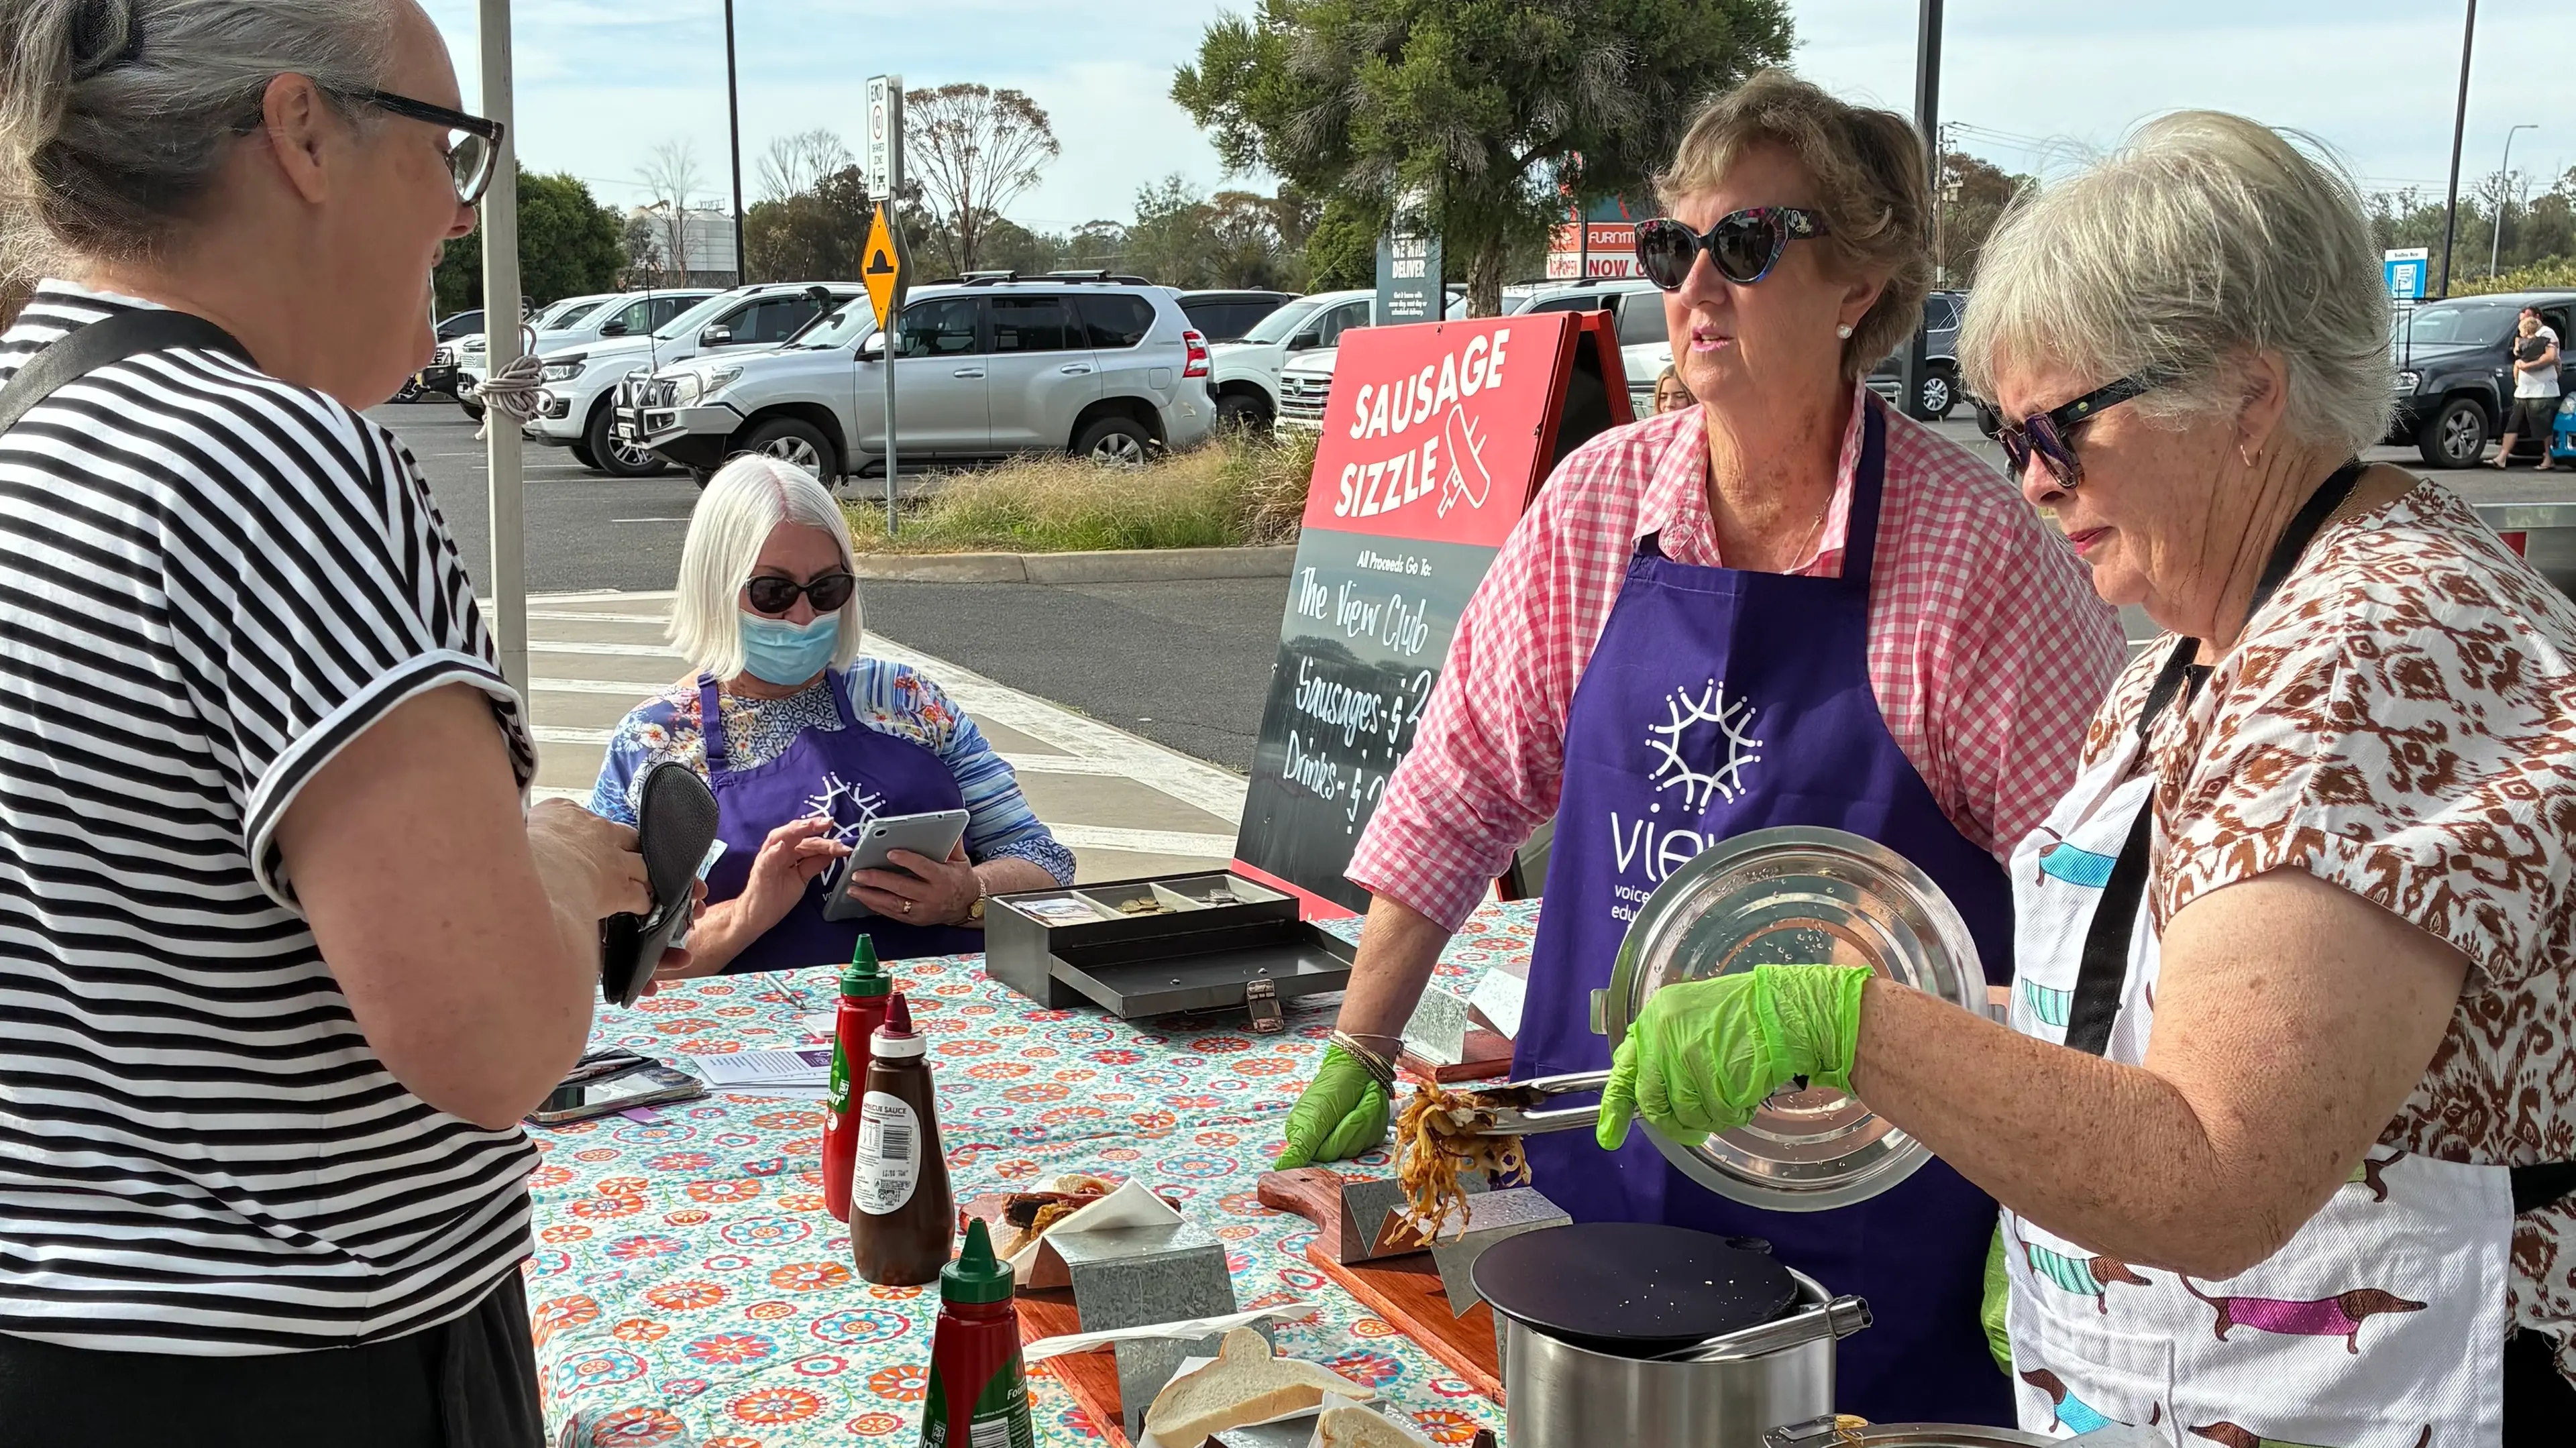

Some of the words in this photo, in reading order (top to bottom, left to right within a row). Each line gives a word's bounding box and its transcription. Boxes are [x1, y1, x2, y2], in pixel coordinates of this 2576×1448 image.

[871, 83, 883, 102] END
[1392, 260, 1426, 278] DELIVER
[1589, 260, 1629, 276] NOW
[1350, 328, 1511, 440] SAUSAGE
[1334, 435, 1440, 518] SIZZLE
[1356, 551, 1368, 568] All
[1370, 552, 1403, 573] Proceeds
[1405, 556, 1419, 573] Go
[1420, 558, 1432, 577] To:
[1297, 566, 1329, 620] The
[1336, 580, 1382, 638] View
[1383, 594, 1430, 656] Club
[1611, 802, 1715, 882] vie
[1615, 885, 1650, 904] voice
